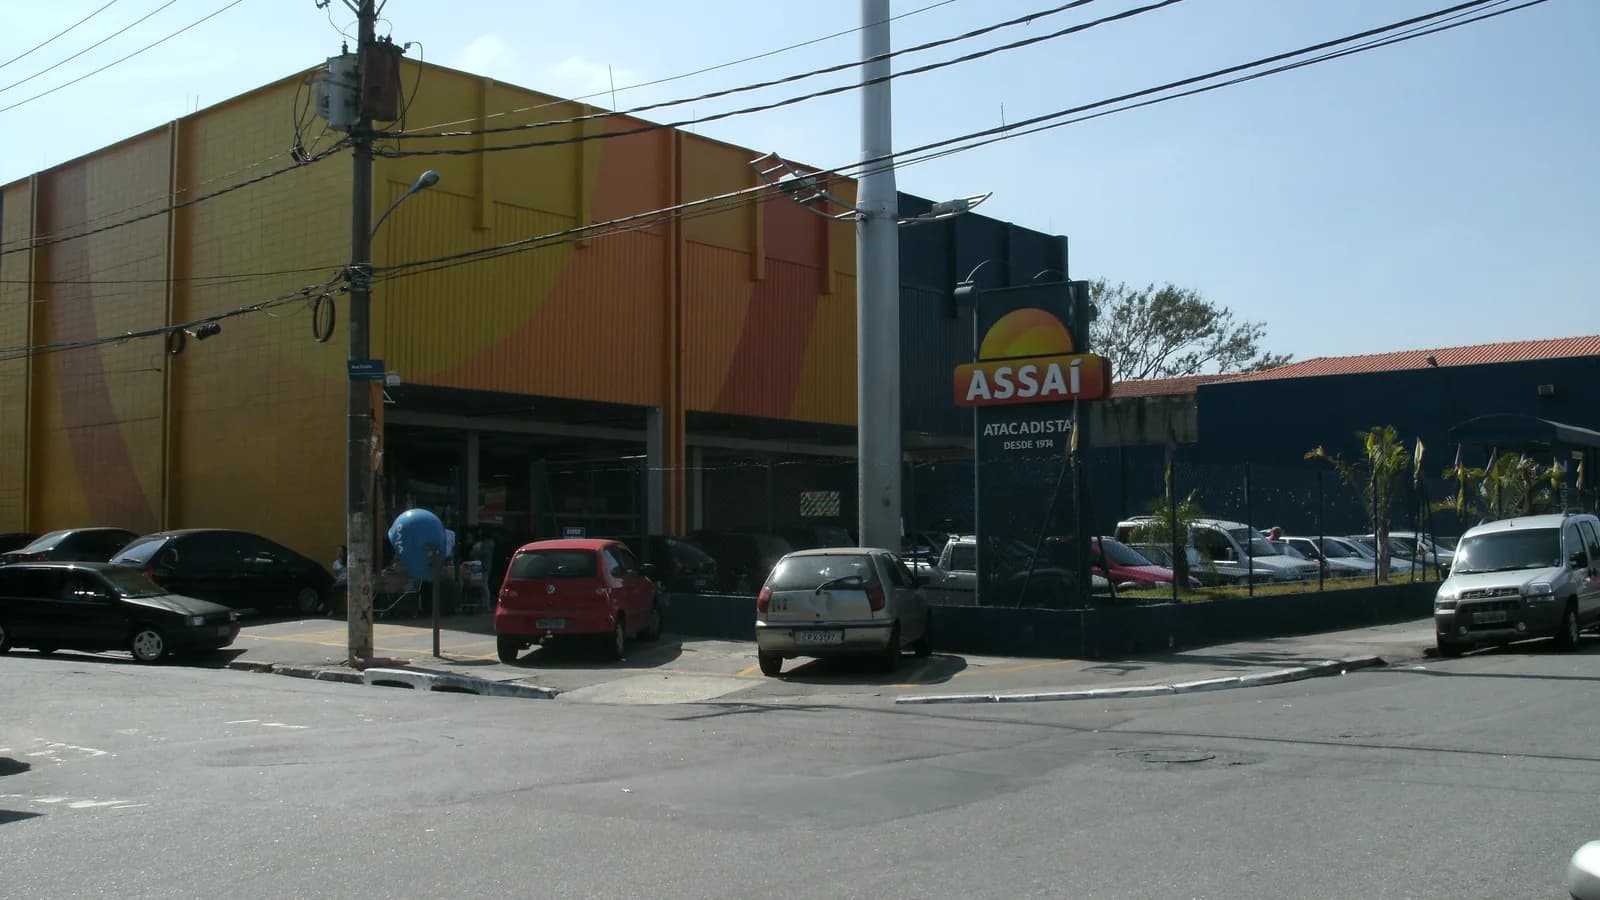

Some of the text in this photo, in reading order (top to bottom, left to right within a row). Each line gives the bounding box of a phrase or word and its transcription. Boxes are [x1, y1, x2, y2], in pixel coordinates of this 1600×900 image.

[966, 358, 1083, 401] ASSAÍ
[983, 419, 1073, 436] ATACADISTA
[1003, 439, 1054, 450] DESDE 1974
